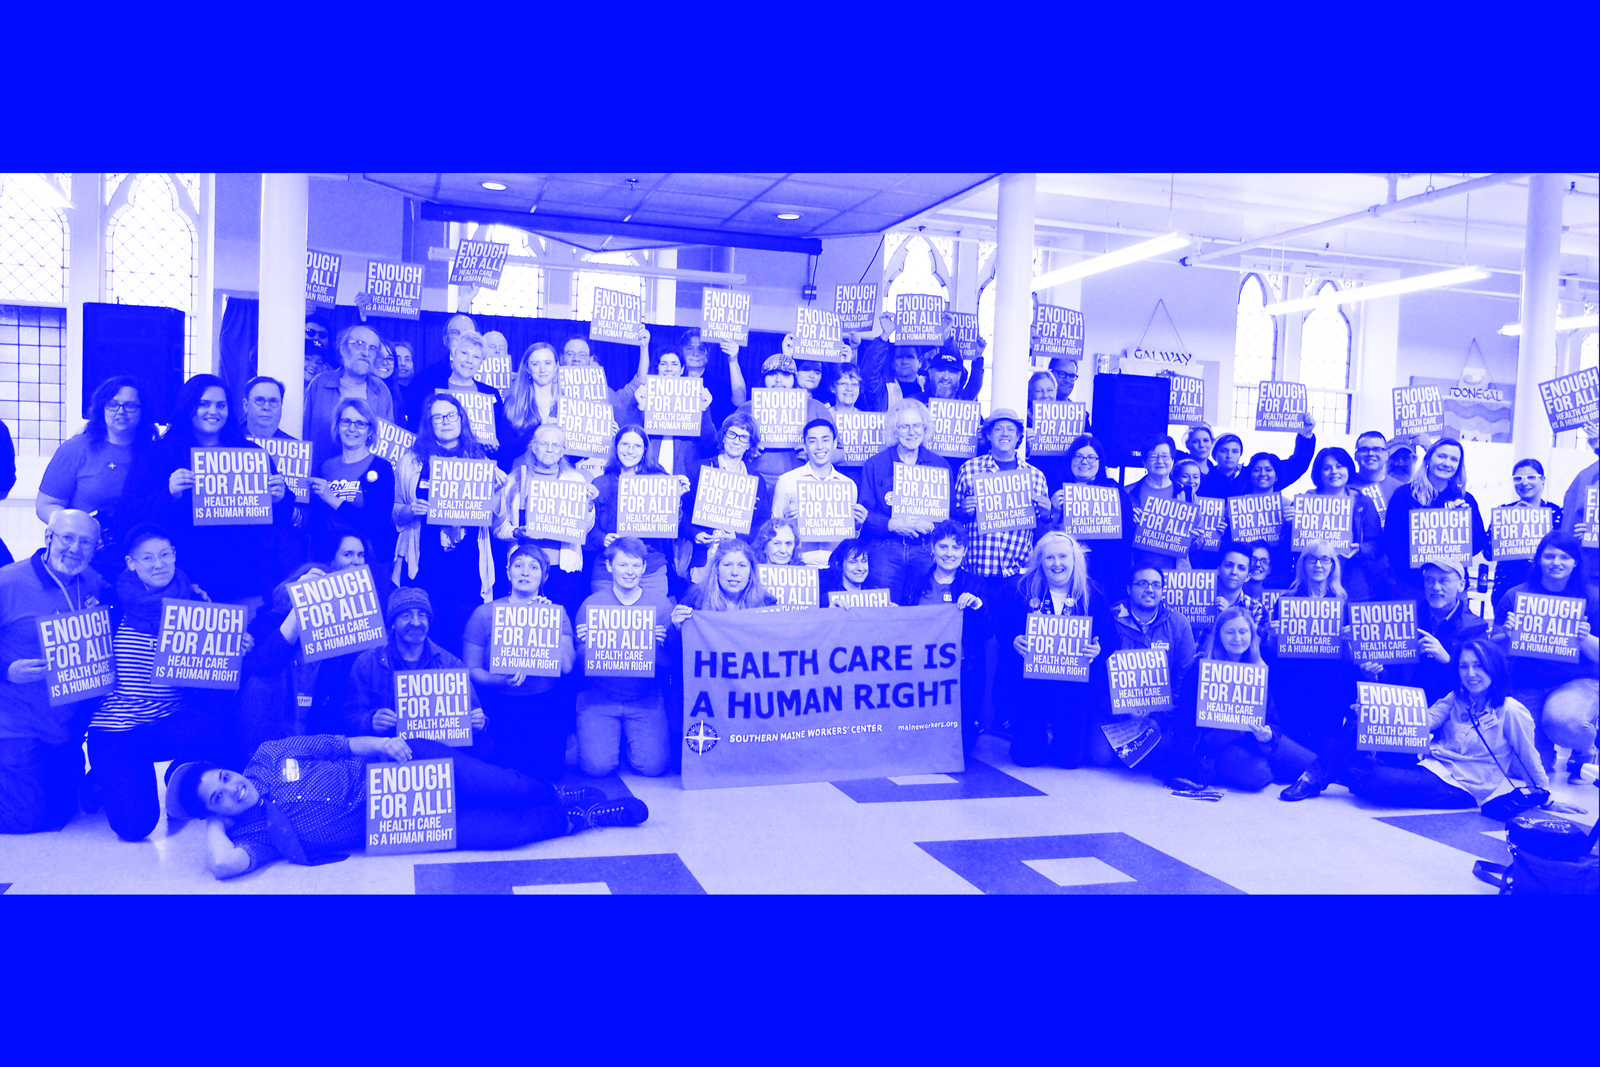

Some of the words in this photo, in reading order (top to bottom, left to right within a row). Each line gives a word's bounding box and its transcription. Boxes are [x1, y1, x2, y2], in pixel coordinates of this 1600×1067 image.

[459, 242, 508, 258] ENOUGH
[456, 256, 478, 269] FOR
[478, 258, 504, 271] ALL!
[369, 262, 422, 284] ENOUGH
[368, 279, 391, 296] FOR
[394, 282, 420, 299] ALL!
[373, 296, 395, 305] HEALTH
[396, 298, 412, 307] CARE
[705, 290, 749, 310] ENOUGH
[366, 303, 372, 311] IS
[378, 304, 400, 313] HUMAN
[401, 307, 419, 315] RIGHT
[704, 306, 724, 322] FOR
[727, 309, 749, 324] ALL!
[1037, 307, 1082, 326] ENOUGH
[1036, 322, 1057, 337] FOR
[1060, 324, 1082, 340] ALL!
[1040, 337, 1061, 346] HEALTH
[1062, 339, 1076, 347] CARE
[1045, 345, 1065, 354] HUMAN
[1066, 347, 1082, 355] RIGHT
[1134, 349, 1192, 365] GALWAY
[1260, 383, 1306, 399] ENOUGH
[1394, 387, 1440, 405] ENOUGH
[1449, 387, 1502, 402] DONEGAL
[1259, 398, 1280, 412] FOR
[1283, 399, 1305, 413] ALL!
[1395, 404, 1417, 420] FOR
[1420, 401, 1442, 417] ALL!
[1268, 420, 1287, 428] HUMAN
[1289, 421, 1305, 429] RIGHT
[1284, 413, 1298, 421] CARE
[1402, 419, 1422, 427] HEALTH
[1423, 417, 1437, 425] CARE
[1396, 428, 1401, 436] IS
[1408, 425, 1428, 435] HUMAN
[1428, 423, 1443, 432] RIGHT
[194, 452, 267, 473] ENOUGH
[433, 460, 493, 482] ENOUGH
[195, 475, 228, 495] FOR
[233, 474, 268, 494] ALL!
[431, 481, 459, 499] FOR
[462, 482, 492, 500] ALL!
[621, 478, 676, 496] ENOUGH
[975, 473, 1030, 496] ENOUGH
[204, 497, 236, 506] HEALTH
[238, 496, 259, 506] CARE
[437, 500, 464, 509] HEALTH
[465, 501, 483, 510] CARE
[620, 496, 644, 513] FOR
[648, 497, 676, 513] ALL!
[978, 495, 1003, 512] FOR
[1006, 491, 1032, 509] ALL!
[196, 508, 204, 518] IS
[206, 508, 212, 517] A
[213, 507, 244, 517] HUMAN
[246, 506, 270, 517] RIGHT
[430, 509, 437, 517] IS
[438, 509, 442, 518] A
[444, 510, 469, 519] HUMAN
[471, 511, 491, 520] RIGHT
[626, 514, 650, 522] HEALTH
[651, 515, 668, 523] CARE
[986, 511, 1009, 520] HEALTH
[1010, 509, 1026, 518] CARE
[620, 523, 625, 531] IS
[627, 523, 631, 531] A
[633, 523, 656, 531] HUMAN
[657, 524, 676, 532] RIGHT
[980, 522, 987, 530] IS
[993, 519, 1015, 528] HUMAN
[1016, 516, 1034, 526] RIGHT
[1517, 595, 1582, 619] ENOUGH
[164, 605, 243, 633] ENOUGH
[495, 606, 560, 628] ENOUGH
[1515, 614, 1543, 633] FOR
[1546, 618, 1579, 637] ALL!
[160, 630, 198, 654] FOR
[202, 633, 241, 656] ALL!
[494, 627, 523, 646] FOR
[527, 629, 559, 648] ALL!
[1520, 632, 1548, 644] HEALTH
[1549, 636, 1569, 646] CARE
[501, 647, 529, 657] HEALTH
[531, 648, 550, 658] CARE
[1512, 641, 1519, 649] IS
[1520, 642, 1525, 650] A
[1527, 642, 1553, 654] HUMAN
[1555, 646, 1577, 656] RIGHT
[167, 655, 203, 668] HEALTH
[204, 657, 229, 669] CARE
[493, 657, 500, 666] IS
[501, 657, 507, 666] A
[509, 658, 535, 668] HUMAN
[537, 659, 559, 669] RIGHT
[694, 649, 819, 679] HEALTH
[829, 645, 913, 673] CARE
[924, 643, 957, 669] IS
[156, 666, 166, 677] IS
[167, 667, 173, 678] A
[176, 668, 210, 680] HUMAN
[212, 670, 239, 681] RIGHT
[690, 691, 715, 718] A
[727, 685, 843, 719] HUMAN
[854, 678, 958, 710] RIGHT
[1360, 686, 1424, 707] ENOUGH
[1361, 705, 1389, 724] FOR
[1394, 707, 1426, 726] ALL!
[729, 732, 779, 743] SOUTHERN
[780, 730, 806, 741] MAINE
[851, 724, 883, 734] CENTER
[897, 720, 958, 732] maineworkers.org
[1368, 725, 1396, 735] HEALTH
[1398, 726, 1417, 737] CARE
[1360, 734, 1366, 744] IS
[1368, 735, 1374, 744] A
[1375, 735, 1403, 746] HUMAN
[1405, 737, 1427, 747] RIGHT
[370, 763, 451, 794] ENOUGH
[371, 793, 407, 820] FOR
[413, 790, 452, 816] ALL!
[380, 819, 415, 832] HEALTH
[418, 816, 441, 830] CARE
[370, 834, 378, 846] IS
[381, 833, 387, 845] A
[390, 830, 424, 844] HUMAN
[426, 828, 453, 842] RIGHT
